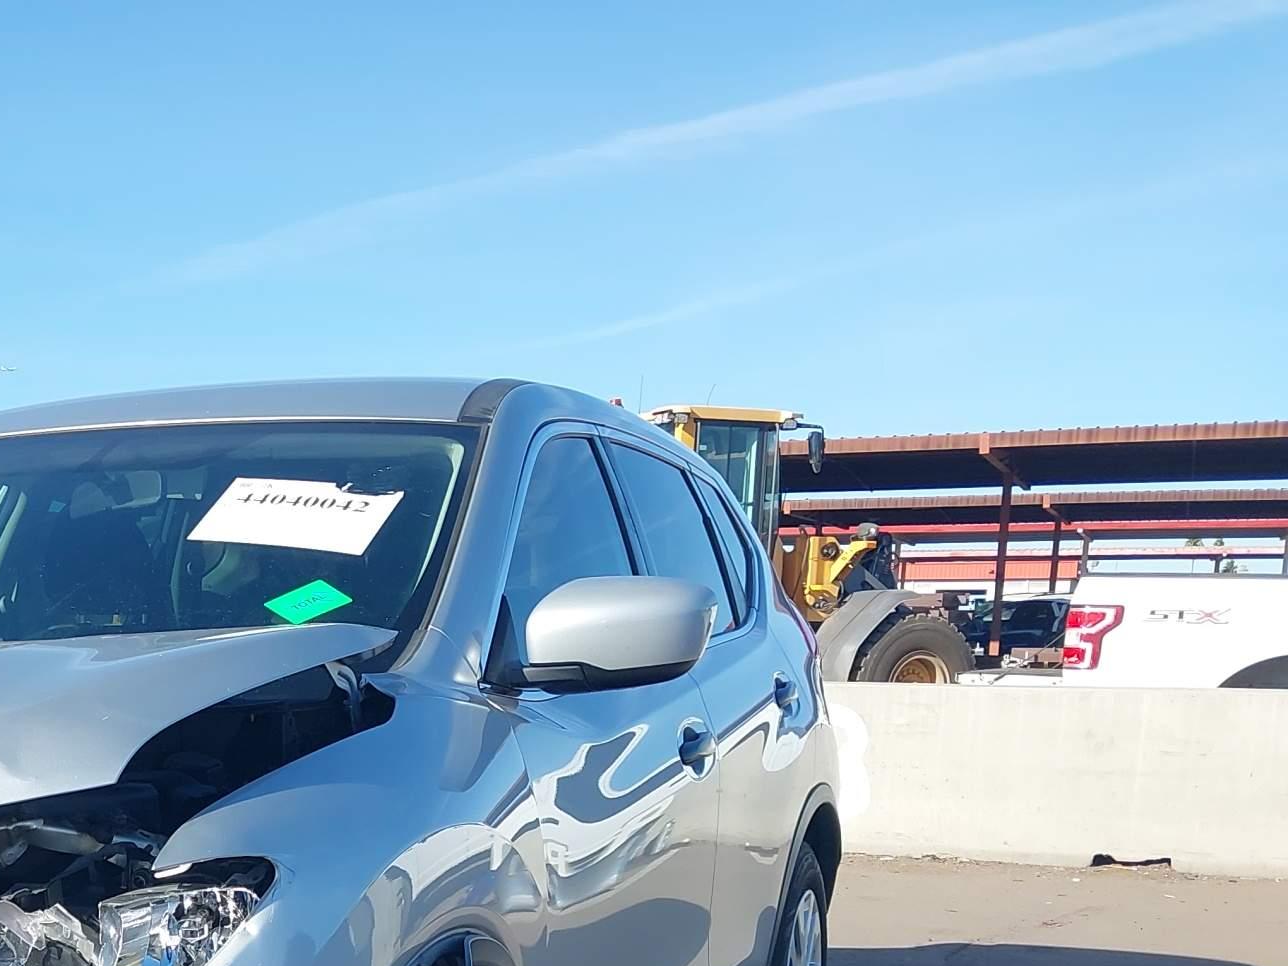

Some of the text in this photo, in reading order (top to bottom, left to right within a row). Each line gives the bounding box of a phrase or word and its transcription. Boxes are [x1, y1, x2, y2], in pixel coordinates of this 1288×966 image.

[237, 493, 370, 512] 44040042
[291, 593, 328, 610] TOTAL
[1143, 608, 1232, 625] STX
